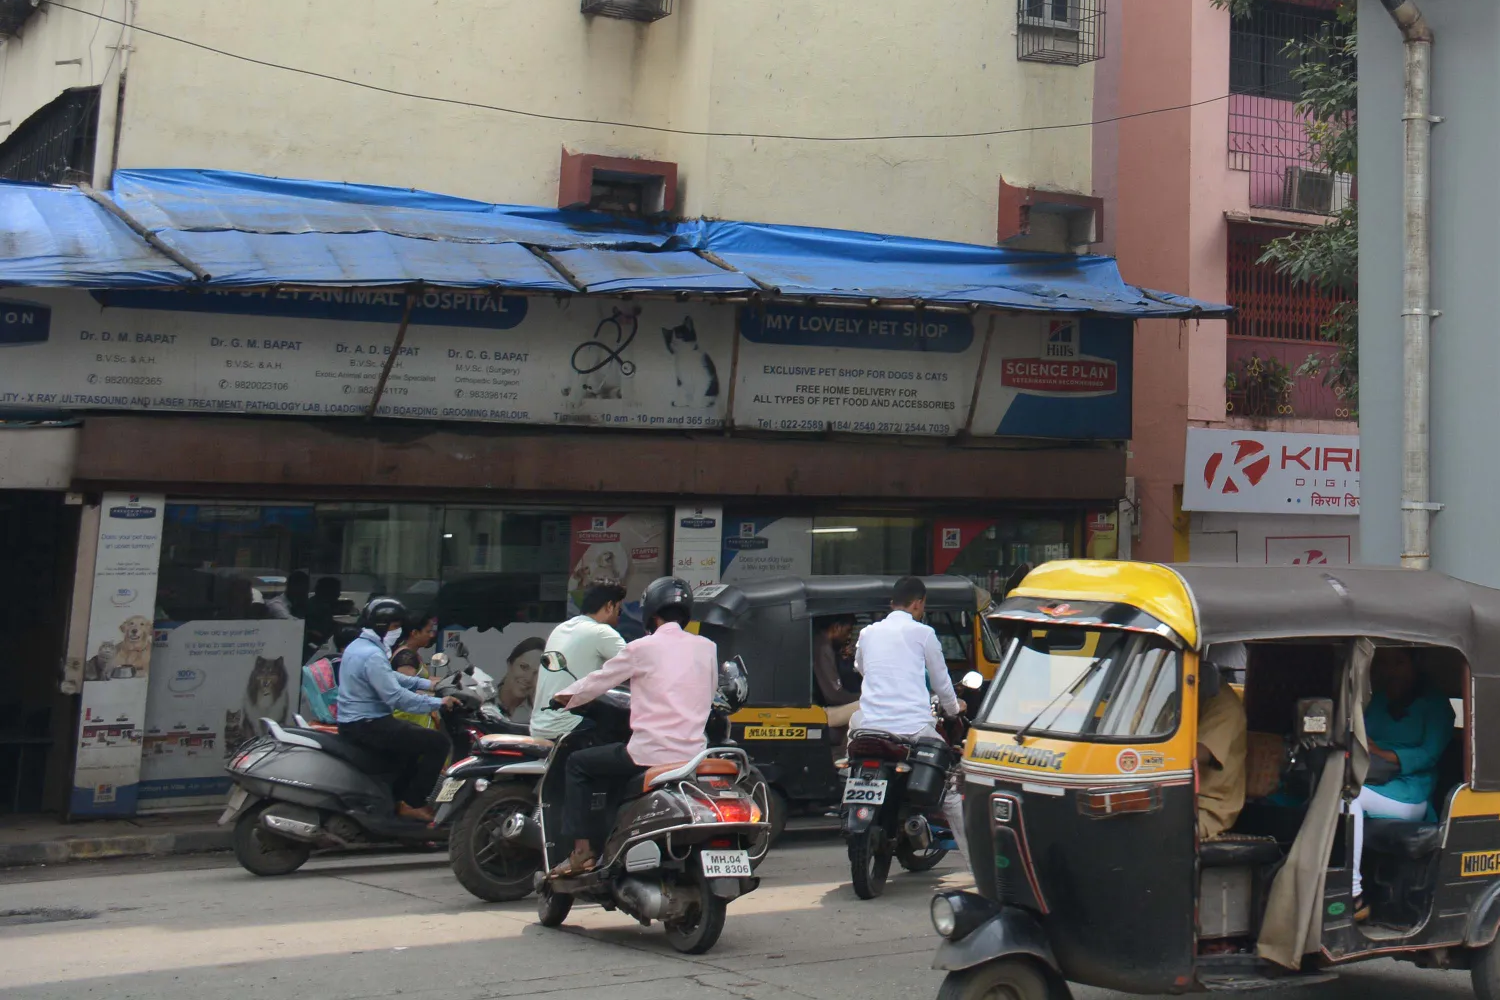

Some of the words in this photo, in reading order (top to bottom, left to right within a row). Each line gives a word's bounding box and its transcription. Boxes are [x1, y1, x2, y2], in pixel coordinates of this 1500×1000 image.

[413, 291, 509, 313] OSPITAL
[766, 313, 795, 331] MY
[799, 315, 864, 334] LOVELY
[868, 319, 898, 336] PET
[903, 321, 949, 339] SHOP
[80, 330, 97, 342] Dr.
[101, 332, 115, 342] D.
[118, 332, 132, 343] M.
[135, 333, 178, 345] BAPAT
[210, 337, 227, 348] Dr.
[231, 338, 245, 348] G.
[247, 339, 260, 349] M.
[263, 339, 303, 351] BAPAT
[336, 343, 351, 354] Dr.
[354, 345, 366, 354] A.
[369, 345, 380, 355] D.
[383, 346, 420, 357] BPAT
[448, 349, 463, 359] Dr.
[466, 350, 477, 360] C.
[480, 351, 491, 361] G.
[494, 352, 530, 363] BAPAT
[1047, 344, 1074, 357] Hill's
[315, 370, 337, 379] Exotic
[338, 371, 362, 380] Animal
[363, 372, 377, 380] and
[403, 373, 437, 383] Specialist
[486, 366, 521, 375] (Surgery)
[763, 364, 816, 376] EXCLUSIVE
[818, 366, 837, 377] PET
[838, 367, 865, 378] SHOP
[866, 368, 886, 379] FOR
[888, 369, 914, 380] DOGS
[916, 371, 923, 380] &
[925, 371, 948, 382] CATS
[1006, 362, 1068, 377] SCIENCE
[1072, 365, 1109, 379] PLAN
[234, 380, 289, 391] 9820023106
[454, 376, 492, 386] Orthopedic
[492, 378, 521, 388] Surgeon
[796, 384, 821, 394] FREE
[822, 385, 850, 395] HOME
[852, 386, 897, 397] DELIVERY
[898, 387, 918, 398] FOR
[27, 393, 35, 403] X
[36, 394, 57, 404] RAY
[130, 396, 150, 407] AND
[152, 398, 184, 408] LASER
[187, 399, 242, 410] TREATMENT
[245, 401, 300, 412] PATHOLOGY
[324, 403, 370, 414] LOADGING
[393, 406, 438, 417] BOARDING
[442, 408, 488, 419] GROOMING
[753, 394, 773, 404] ALL
[774, 395, 805, 405] TYPES
[807, 396, 820, 405] OF
[822, 396, 840, 406] PET
[843, 397, 869, 407] FOOD
[870, 398, 890, 408] AND
[892, 399, 956, 410] ACCESSORIES
[600, 413, 612, 422] 10
[614, 415, 629, 423] am
[637, 414, 648, 423] 10
[650, 416, 665, 425] pm
[667, 415, 685, 424] and
[687, 416, 703, 425] 365
[757, 418, 772, 429] Tel
[780, 419, 824, 430] 022-2589
[854, 422, 876, 432] 2540
[905, 423, 927, 433] 2544
[929, 423, 950, 433] 7039
[1311, 491, 1341, 507] किरण
[768, 556, 780, 565] dog
[846, 789, 883, 801] 2201
[711, 855, 741, 864] MH.04
[706, 865, 721, 874] HR
[725, 864, 749, 874] 8306
